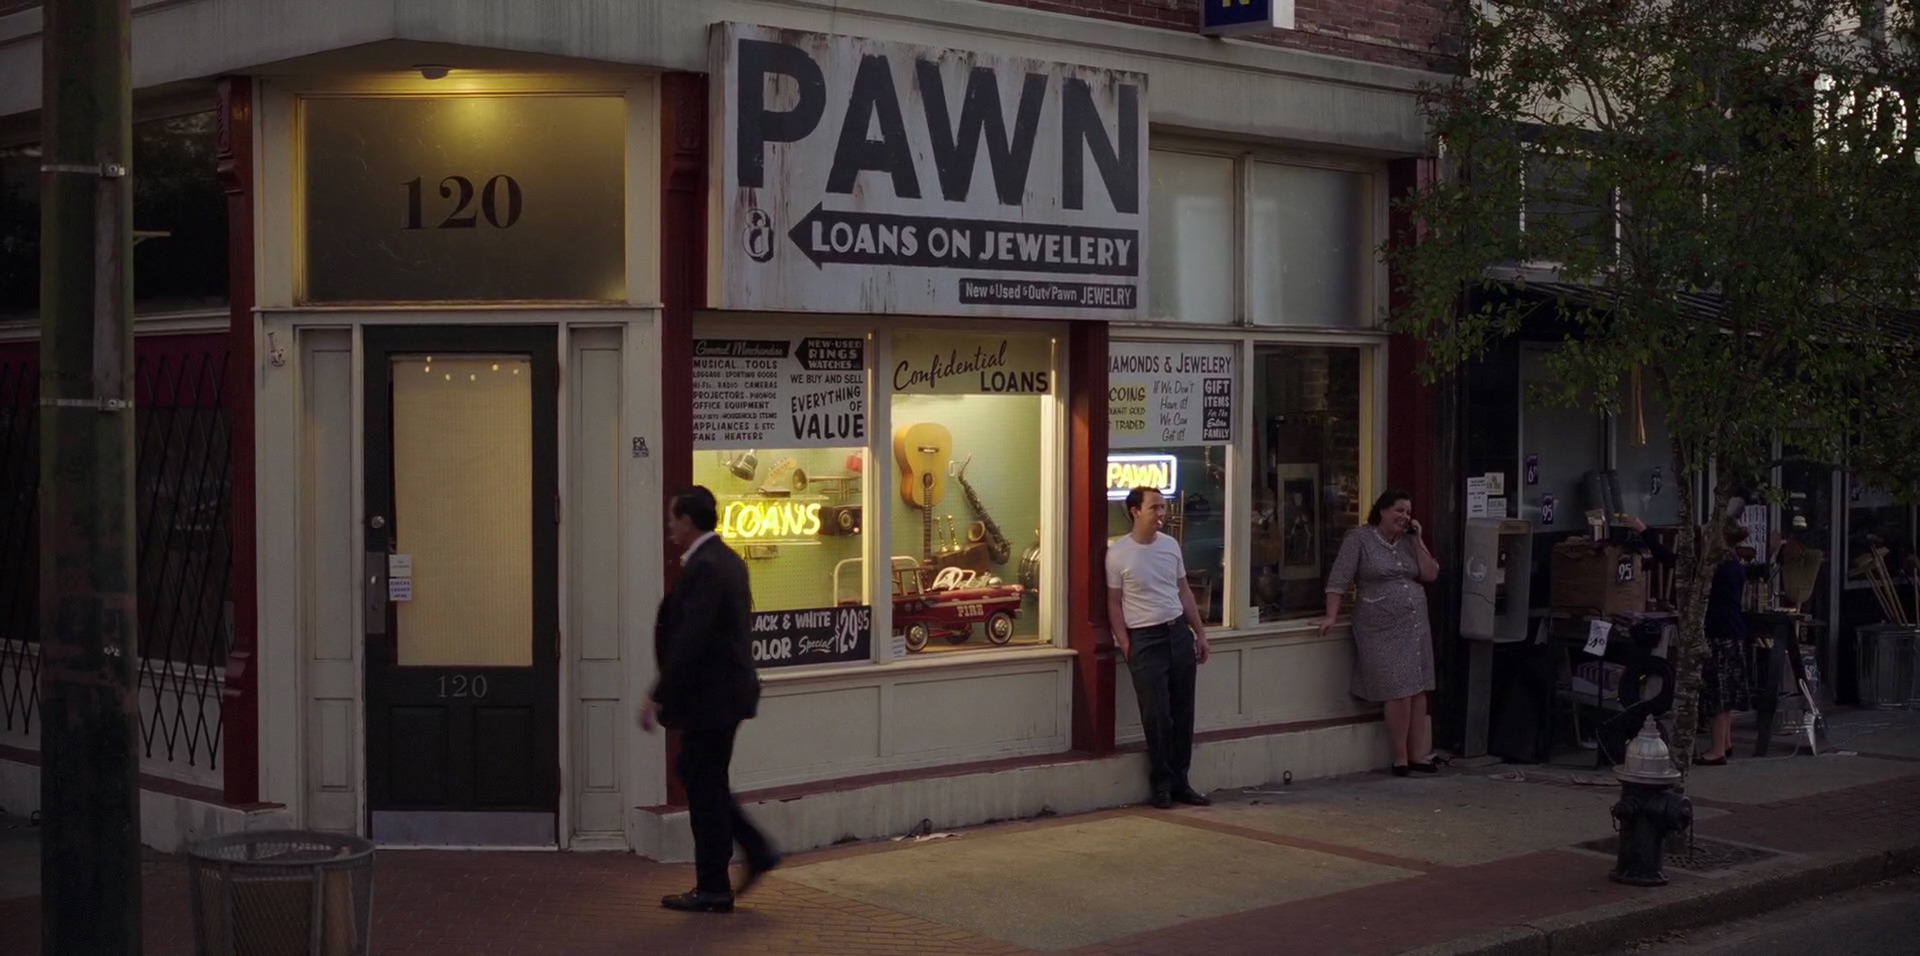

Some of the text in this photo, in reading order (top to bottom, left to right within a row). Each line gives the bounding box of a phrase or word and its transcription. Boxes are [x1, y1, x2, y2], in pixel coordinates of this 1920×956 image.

[738, 38, 1139, 215] PAWN
[400, 174, 523, 230] 120
[811, 221, 1132, 266] LOANS ON JEWELERY
[965, 281, 987, 298] New
[996, 283, 1021, 300] Used
[1053, 286, 1077, 301] Pawn
[1080, 286, 1132, 306] JEWELRY
[808, 348, 858, 360] RINGS
[1108, 355, 1160, 373] IAMONDS
[1176, 352, 1232, 373] JEWELERY
[693, 360, 777, 369] MUSICAL TOOLS
[807, 360, 853, 370] WATCHES
[893, 339, 1007, 391] Confidential
[744, 380, 777, 389] CAMERAS
[791, 374, 863, 384] WE BUY AND SELL
[981, 371, 1048, 392] LOANS
[1204, 379, 1230, 396] GIFT
[693, 391, 744, 400] PROJECTORS
[791, 386, 861, 413] EVERYTHING
[1109, 387, 1146, 402] COINS
[1204, 395, 1230, 409] ITEMS
[693, 401, 769, 410] OFFICE EQUIPMENT
[849, 401, 862, 411] OF
[693, 421, 749, 430] APPLIANCES
[792, 413, 864, 439] VALUE
[1203, 428, 1230, 440] FAMILY
[693, 432, 763, 441] FANS HEATERS
[1107, 462, 1168, 488] PAWN
[722, 502, 822, 539] LOANS
[956, 604, 985, 617] FIRE
[782, 614, 792, 630] &
[795, 611, 832, 629] WHITE
[752, 637, 792, 660] OLOR
[437, 674, 488, 698] 120
